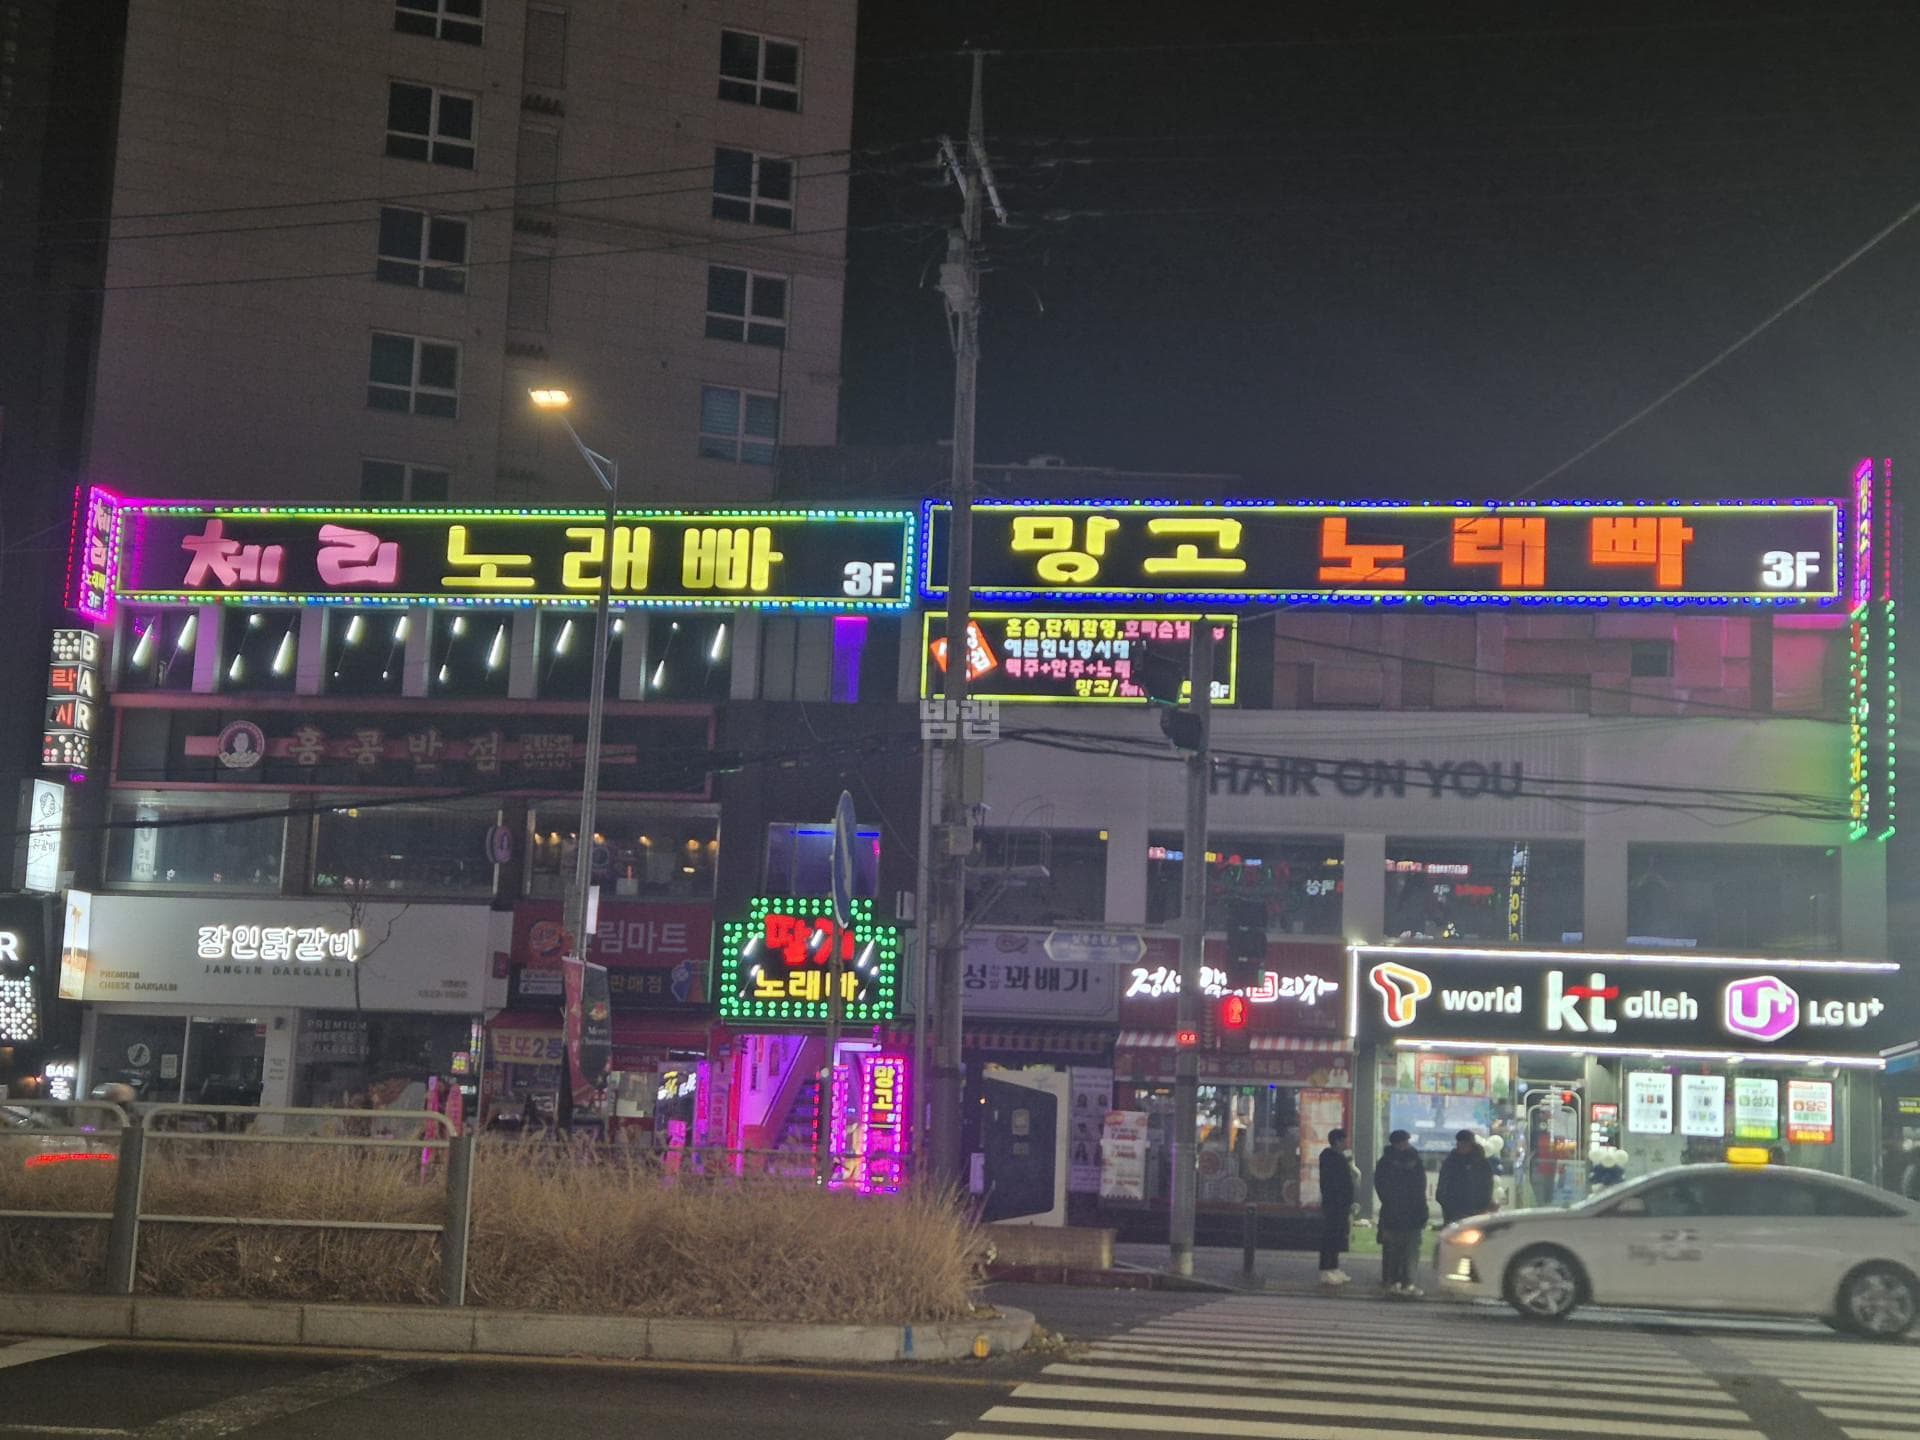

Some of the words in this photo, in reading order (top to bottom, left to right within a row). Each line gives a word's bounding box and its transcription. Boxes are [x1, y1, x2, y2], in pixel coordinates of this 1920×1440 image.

[182, 519, 399, 586] 체리
[440, 525, 784, 591] 노래빠
[842, 561, 895, 596] 3F
[1010, 516, 1248, 583] 망고
[1318, 517, 1694, 587] 노래빠
[1761, 550, 1821, 589] 3F
[77, 634, 95, 731] BAR
[1209, 681, 1230, 698] 3F
[289, 726, 501, 772] 홍콩반점
[1209, 756, 1320, 797] HAIR
[1335, 757, 1407, 798] ON
[1420, 758, 1524, 799] YOU
[197, 924, 361, 962] 장인닭갈비
[204, 965, 262, 976] JANGIN
[271, 966, 352, 977] DAKGALBI
[1442, 985, 1523, 1015] world
[1545, 969, 1620, 1034] kt
[1624, 990, 1699, 1021] olleh
[45, 1063, 75, 1078] BAR
[872, 1064, 896, 1111] 망고
